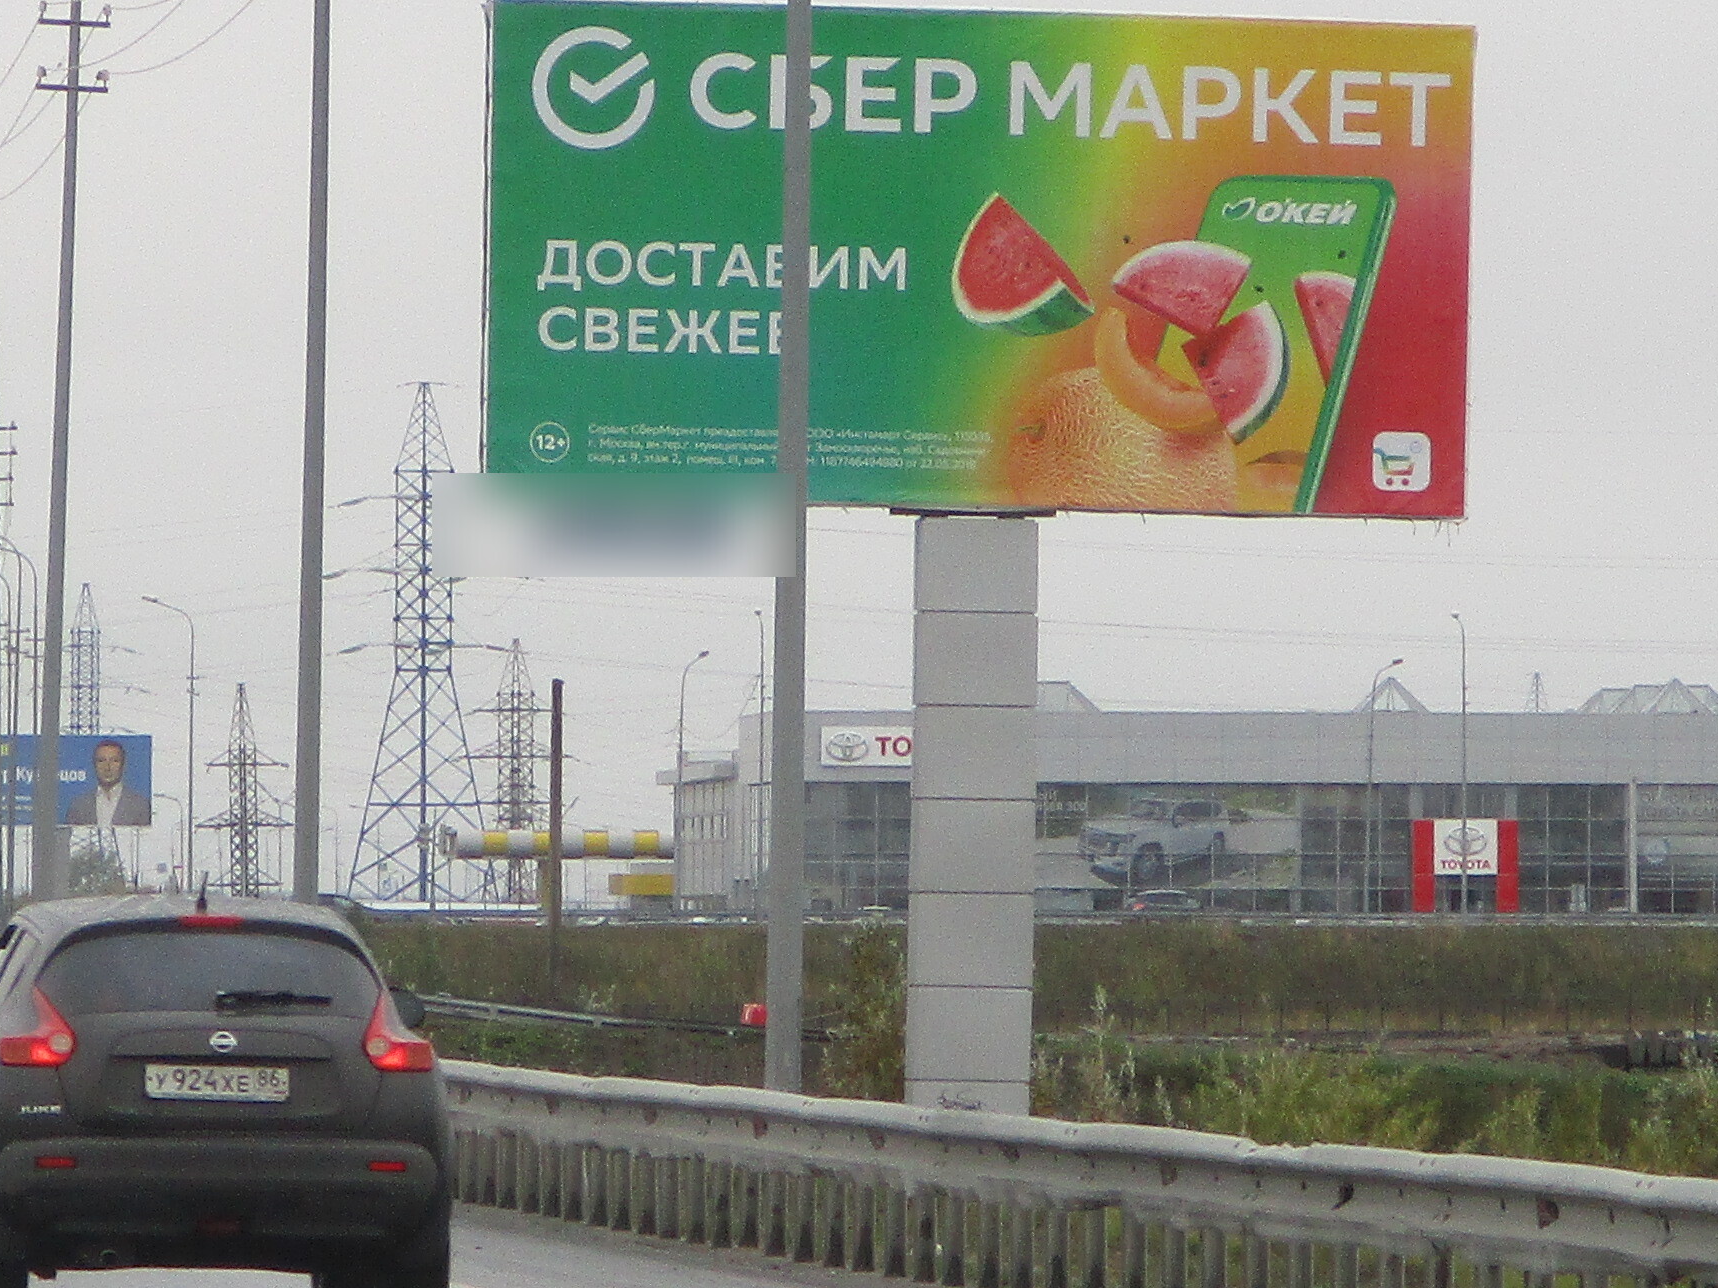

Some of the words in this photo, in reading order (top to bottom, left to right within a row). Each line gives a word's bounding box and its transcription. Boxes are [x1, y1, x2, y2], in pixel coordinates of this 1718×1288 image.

[690, 52, 978, 133] СБЕР
[1008, 60, 1451, 148] МАРКЕТ
[537, 239, 907, 292] ДОСТАВИМ
[536, 433, 566, 451] 12+
[15, 765, 87, 785] Куцов
[1440, 858, 1492, 870] TOYOTA
